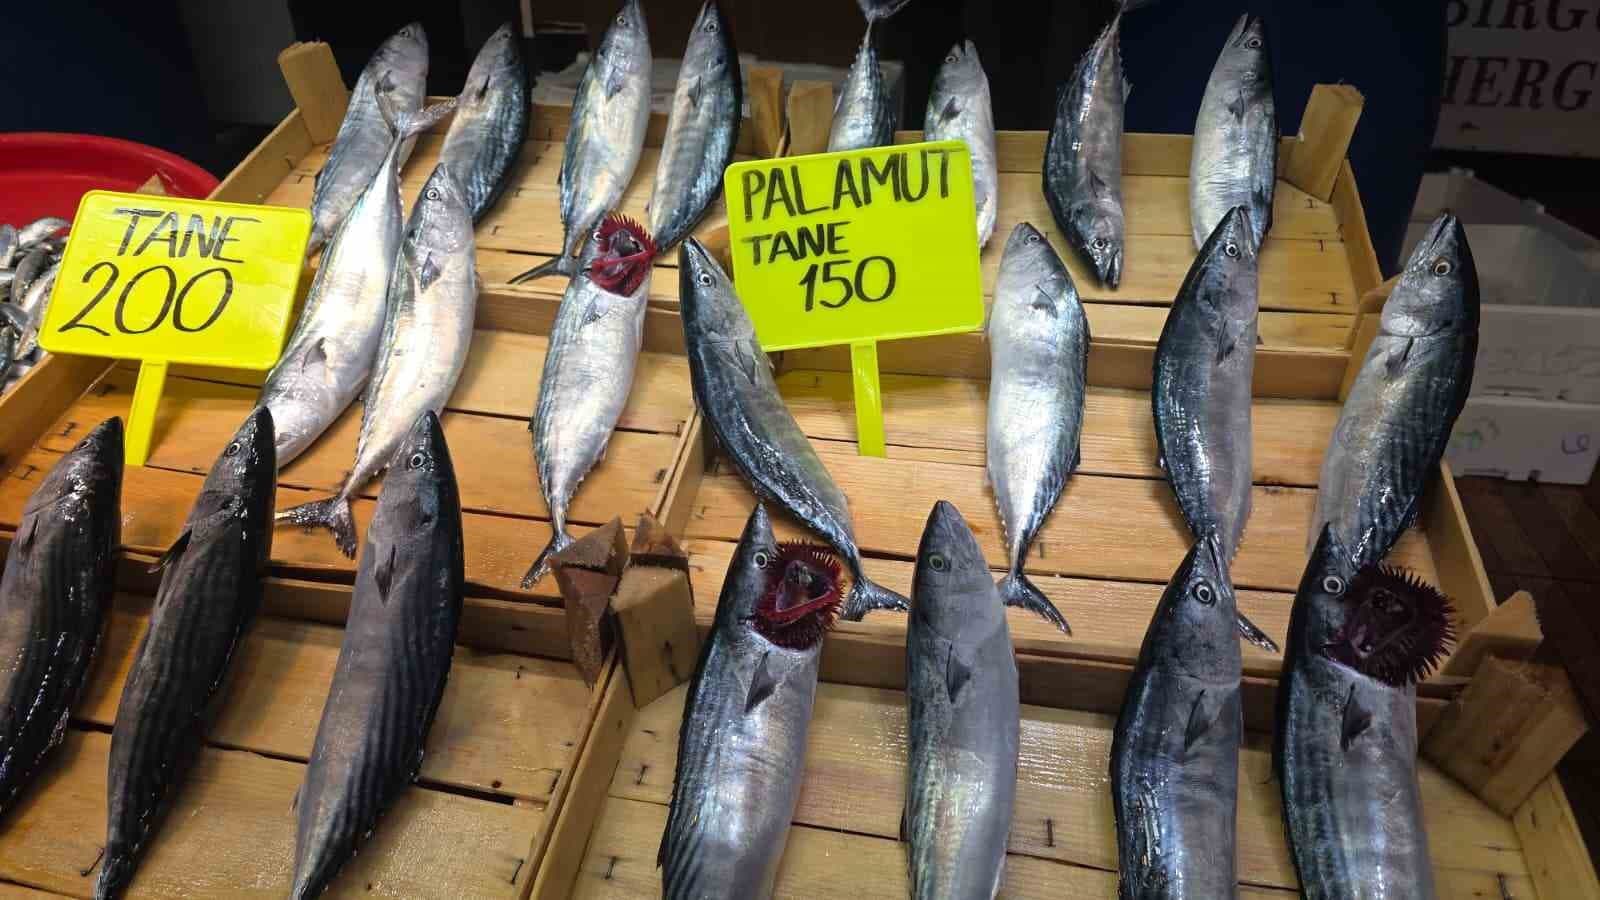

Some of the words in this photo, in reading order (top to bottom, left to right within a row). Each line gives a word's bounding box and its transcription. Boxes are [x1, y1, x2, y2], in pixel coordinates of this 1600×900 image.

[1447, 0, 1600, 32] IRG
[741, 148, 963, 223] PALAMUT
[113, 207, 263, 264] TANE
[742, 220, 852, 266] TANE
[57, 261, 233, 337] 200
[798, 255, 897, 313] 150
